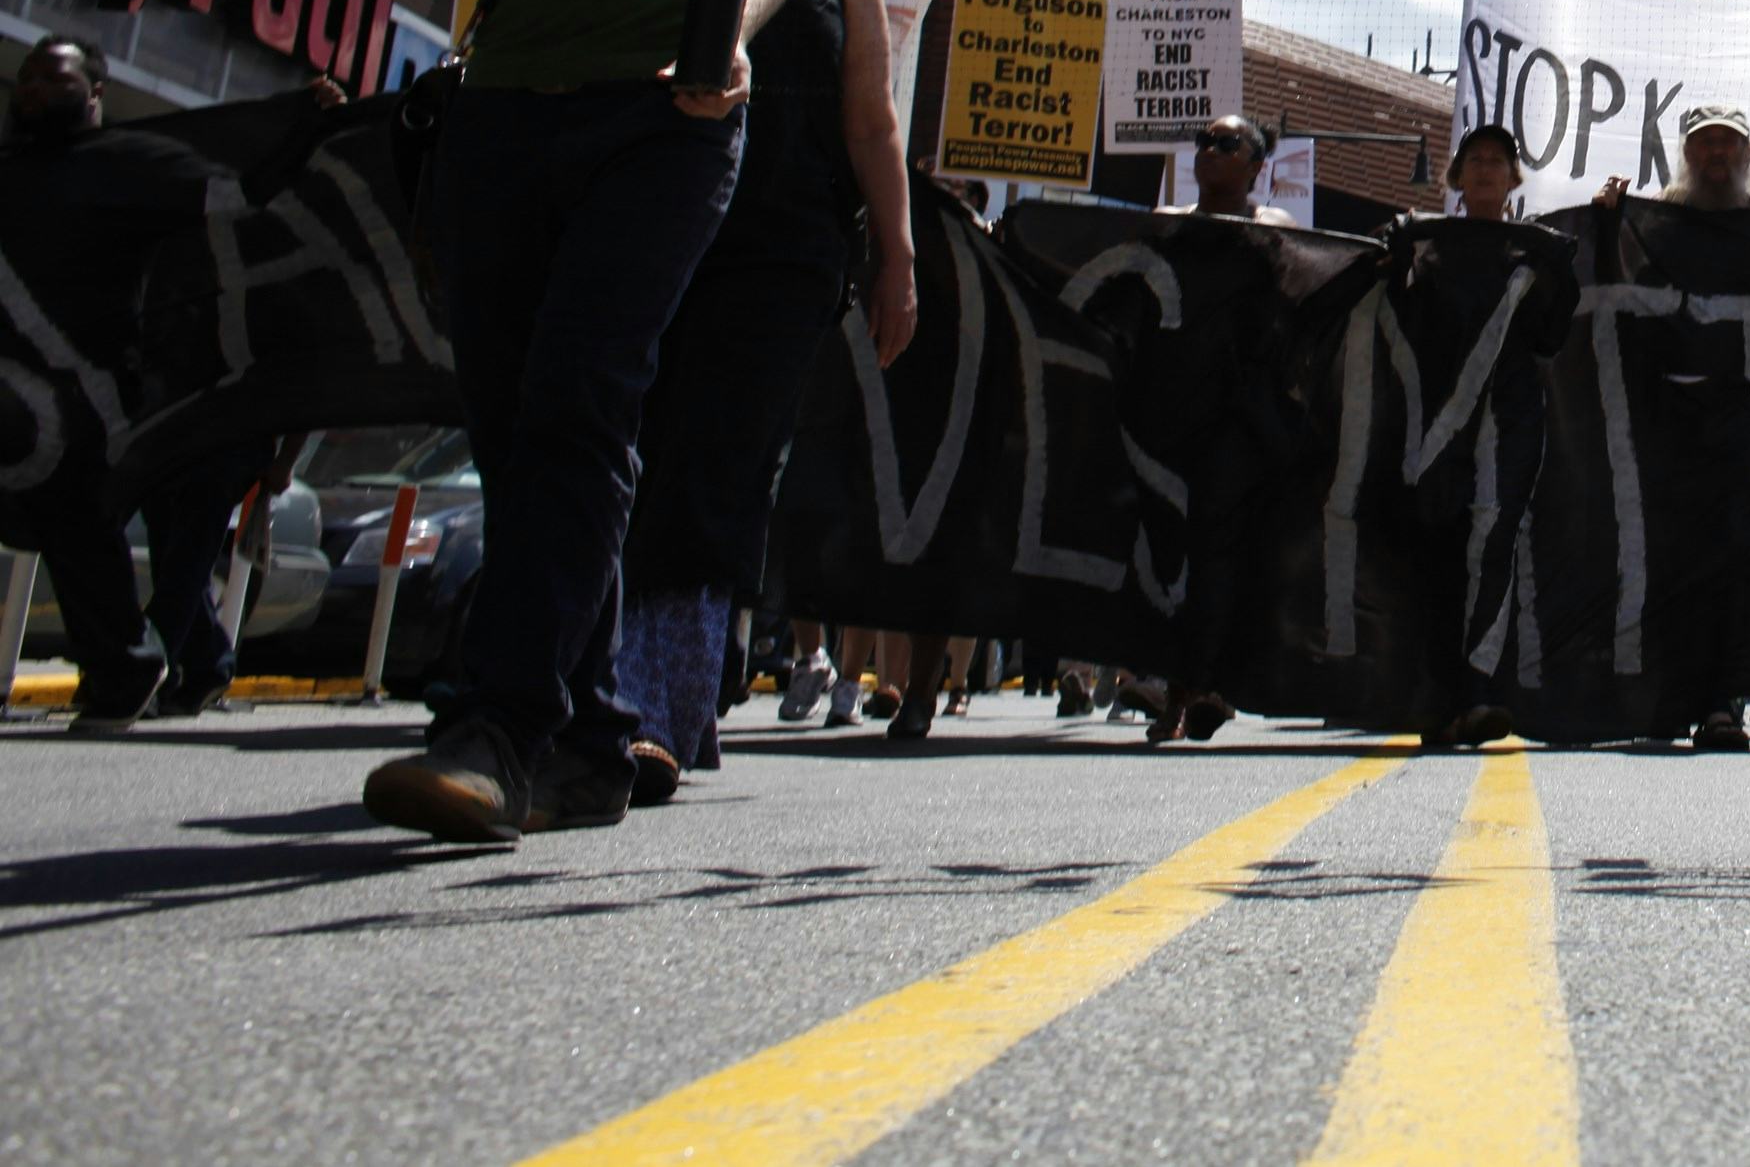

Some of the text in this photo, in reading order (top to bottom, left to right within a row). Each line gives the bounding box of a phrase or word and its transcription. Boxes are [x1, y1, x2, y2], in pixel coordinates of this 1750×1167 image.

[1024, 16, 1044, 33] to
[1116, 7, 1231, 21] CHARLESTON
[958, 29, 1100, 64] Charleston
[1142, 28, 1205, 41] TO NYC
[1155, 43, 1192, 65] END
[995, 57, 1053, 85] End
[1137, 68, 1211, 92] RACIST
[969, 82, 1072, 116] Racist
[1134, 95, 1212, 118] TERROR
[1464, 18, 1626, 179] STOP
[969, 112, 1074, 146] Terror!
[950, 152, 1083, 176] peoplespower.net
